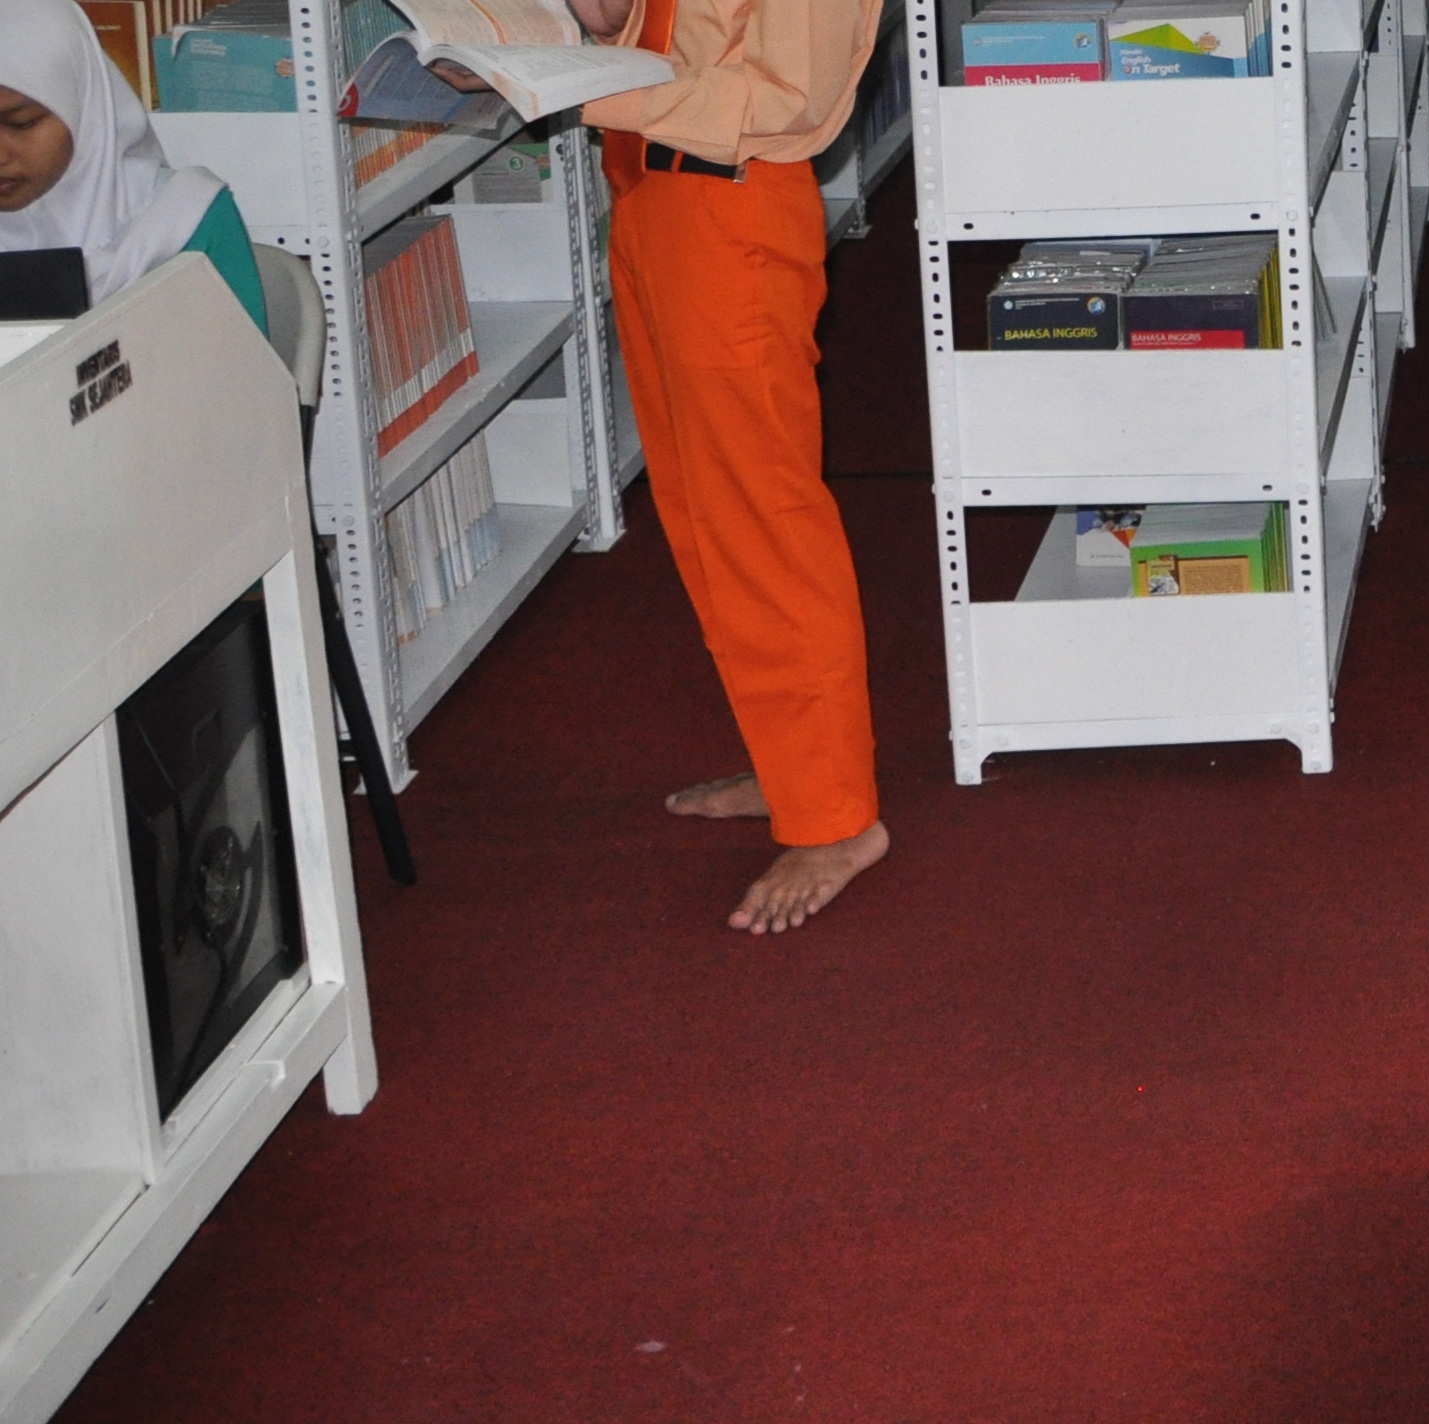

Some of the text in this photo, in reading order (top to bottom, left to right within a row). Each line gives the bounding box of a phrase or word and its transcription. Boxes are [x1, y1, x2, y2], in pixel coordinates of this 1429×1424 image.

[1121, 55, 1151, 66] English
[1142, 63, 1180, 77] Target
[984, 74, 1032, 86] Bahasa
[1004, 327, 1098, 341] BAHASA INGGRIS
[1132, 333, 1202, 342] BAHASA INGGRIS
